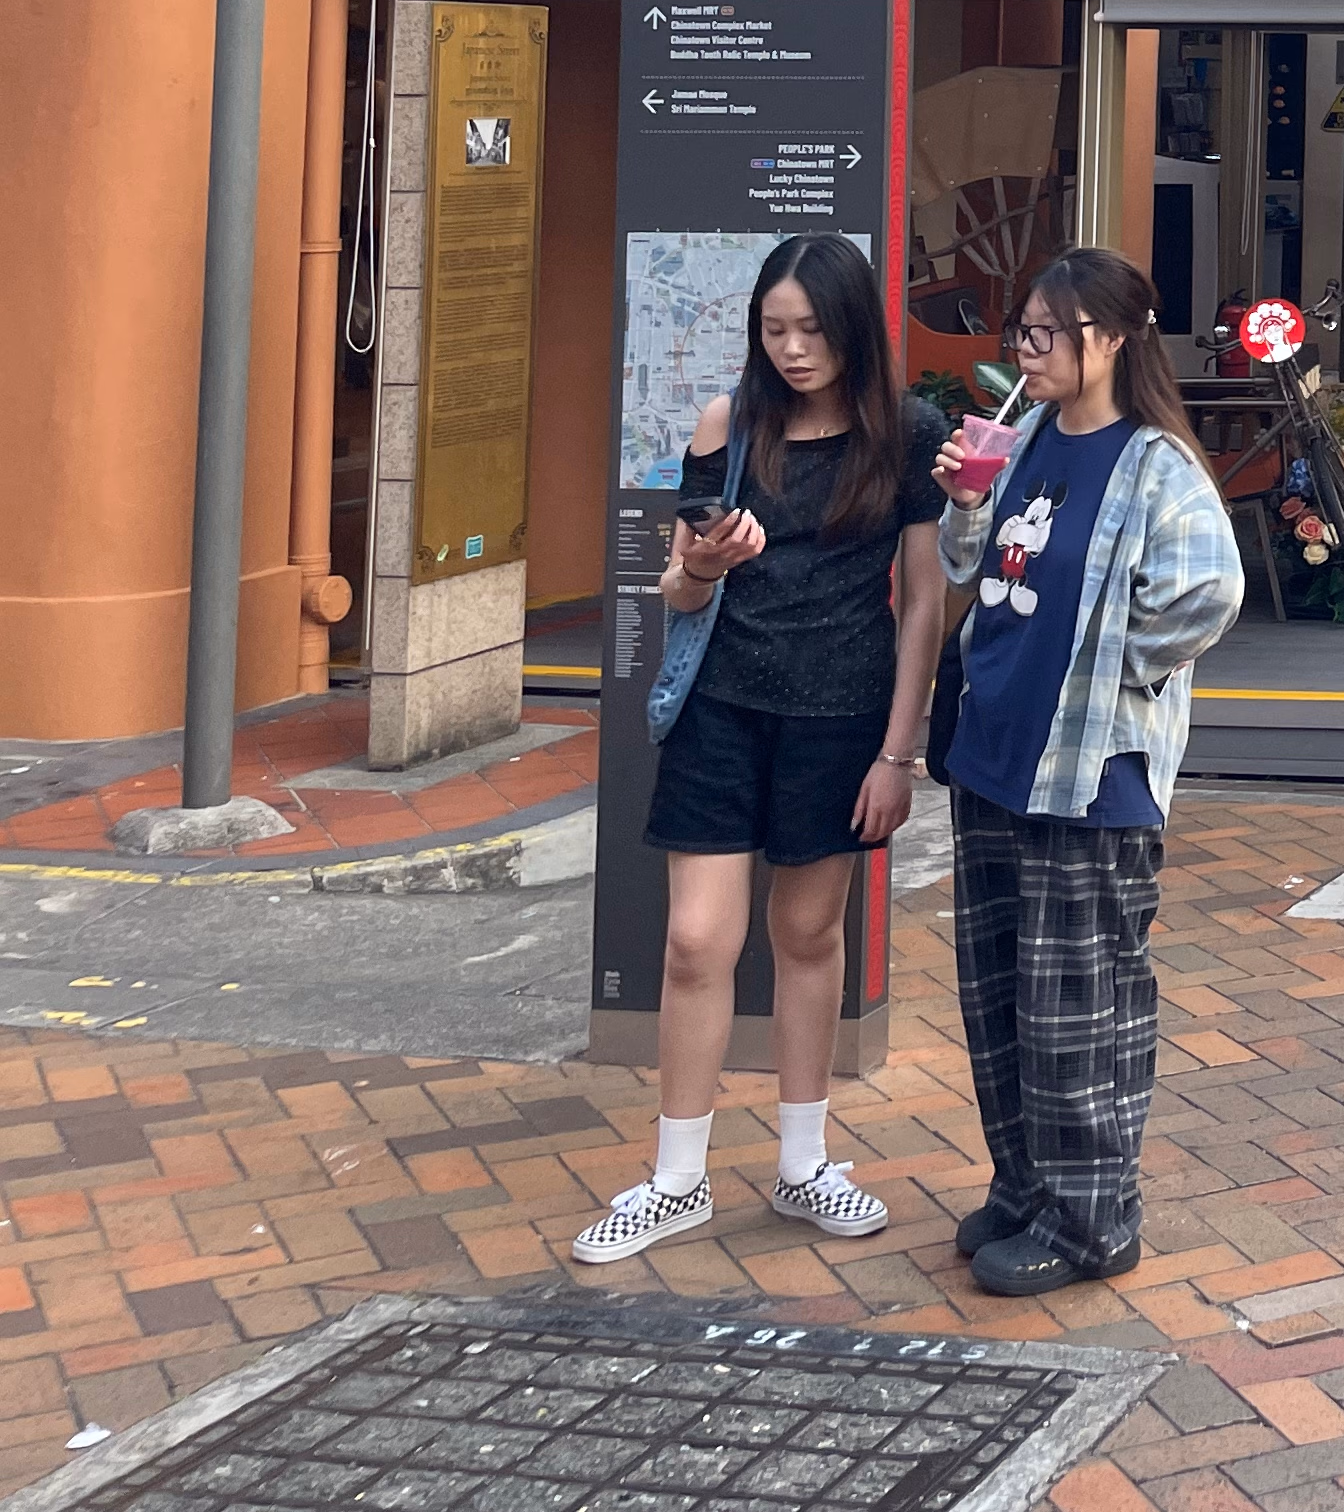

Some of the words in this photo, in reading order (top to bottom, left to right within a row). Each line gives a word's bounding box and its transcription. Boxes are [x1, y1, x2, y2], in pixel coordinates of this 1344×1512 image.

[703, 5, 719, 16] MRT
[670, 20, 711, 30] Chinatown
[745, 21, 772, 30] Market
[670, 35, 711, 45] Chinatown
[778, 144, 813, 154] PEOPLE'S
[814, 144, 835, 154] PARK
[777, 159, 817, 169] Chinatown
[818, 159, 834, 169] MRT
[769, 174, 793, 185] Lucky
[794, 174, 834, 184] Chinatown
[748, 188, 780, 200] People's
[781, 188, 799, 198] Park
